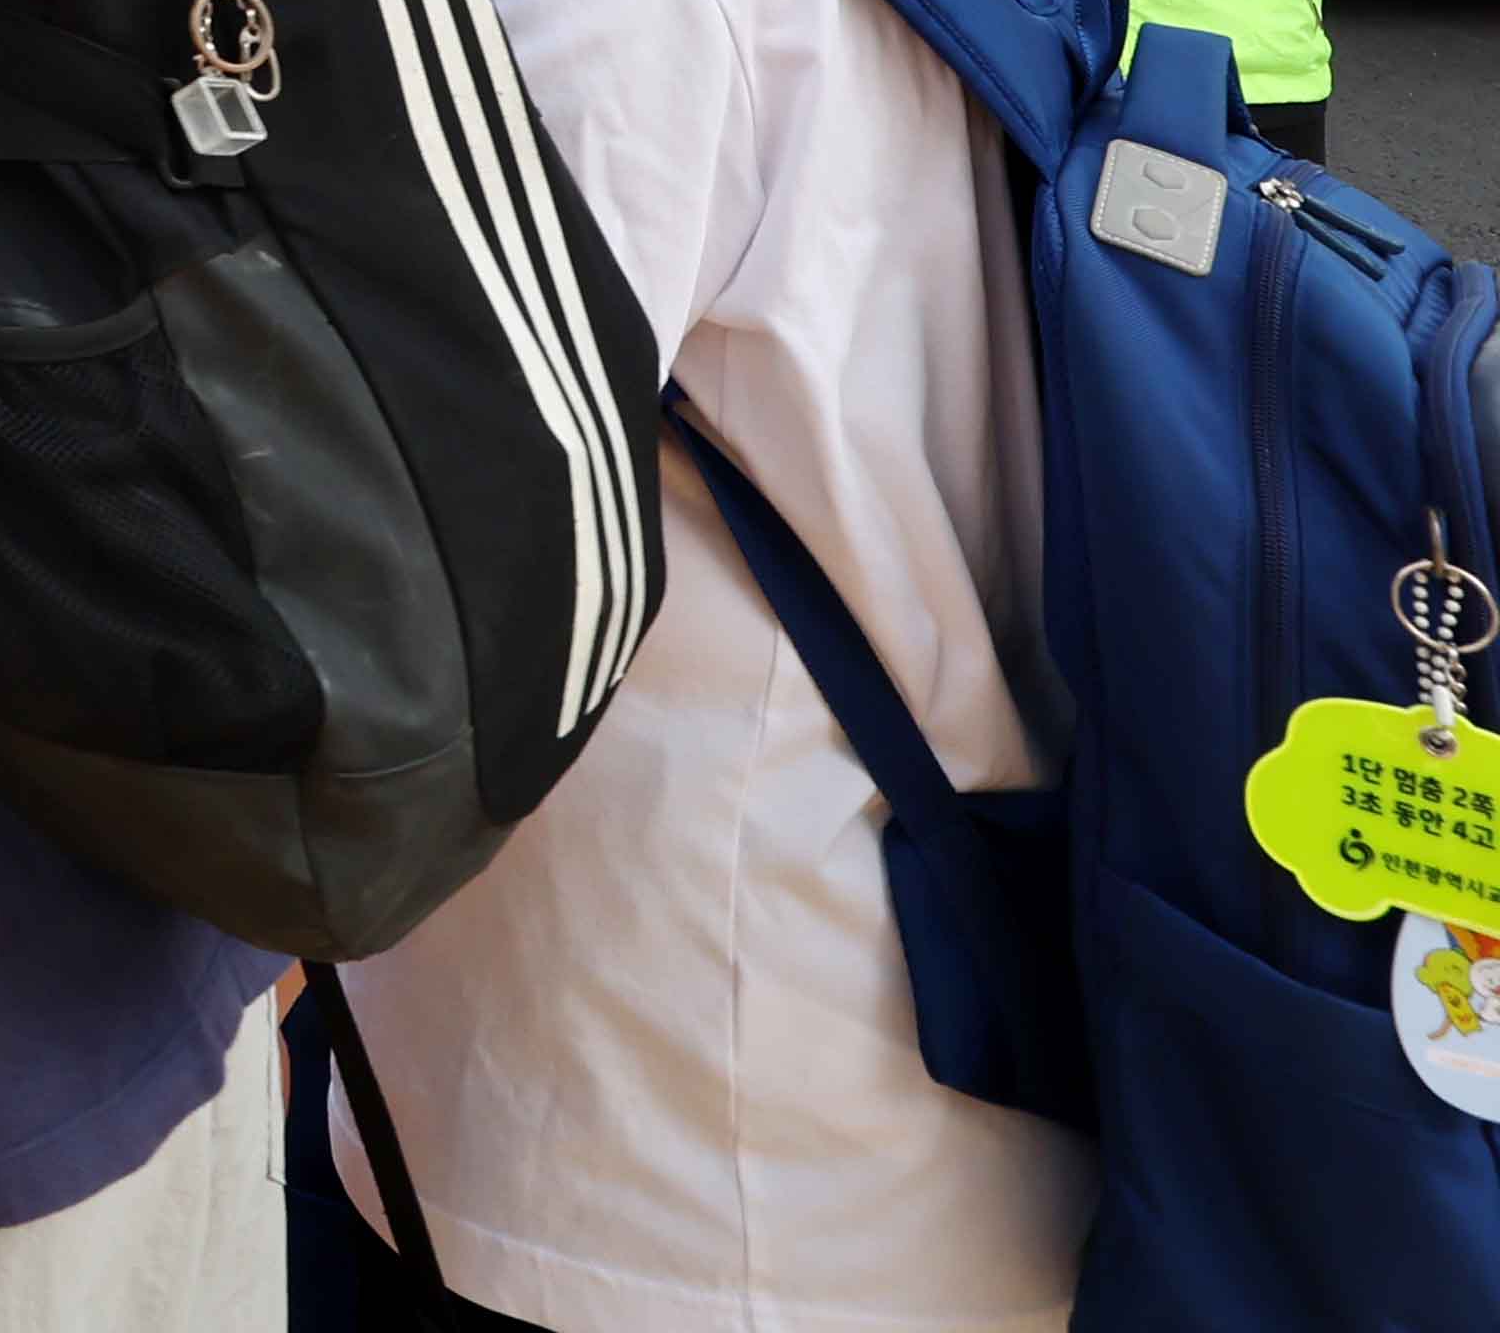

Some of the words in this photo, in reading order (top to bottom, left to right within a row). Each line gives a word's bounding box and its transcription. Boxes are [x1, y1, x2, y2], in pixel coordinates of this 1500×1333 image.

[1342, 753, 1384, 785] 1단
[1393, 766, 1445, 804] 멈춤
[1341, 784, 1384, 816] 3초
[1393, 799, 1445, 838] 동안
[1452, 820, 1497, 851] 4고
